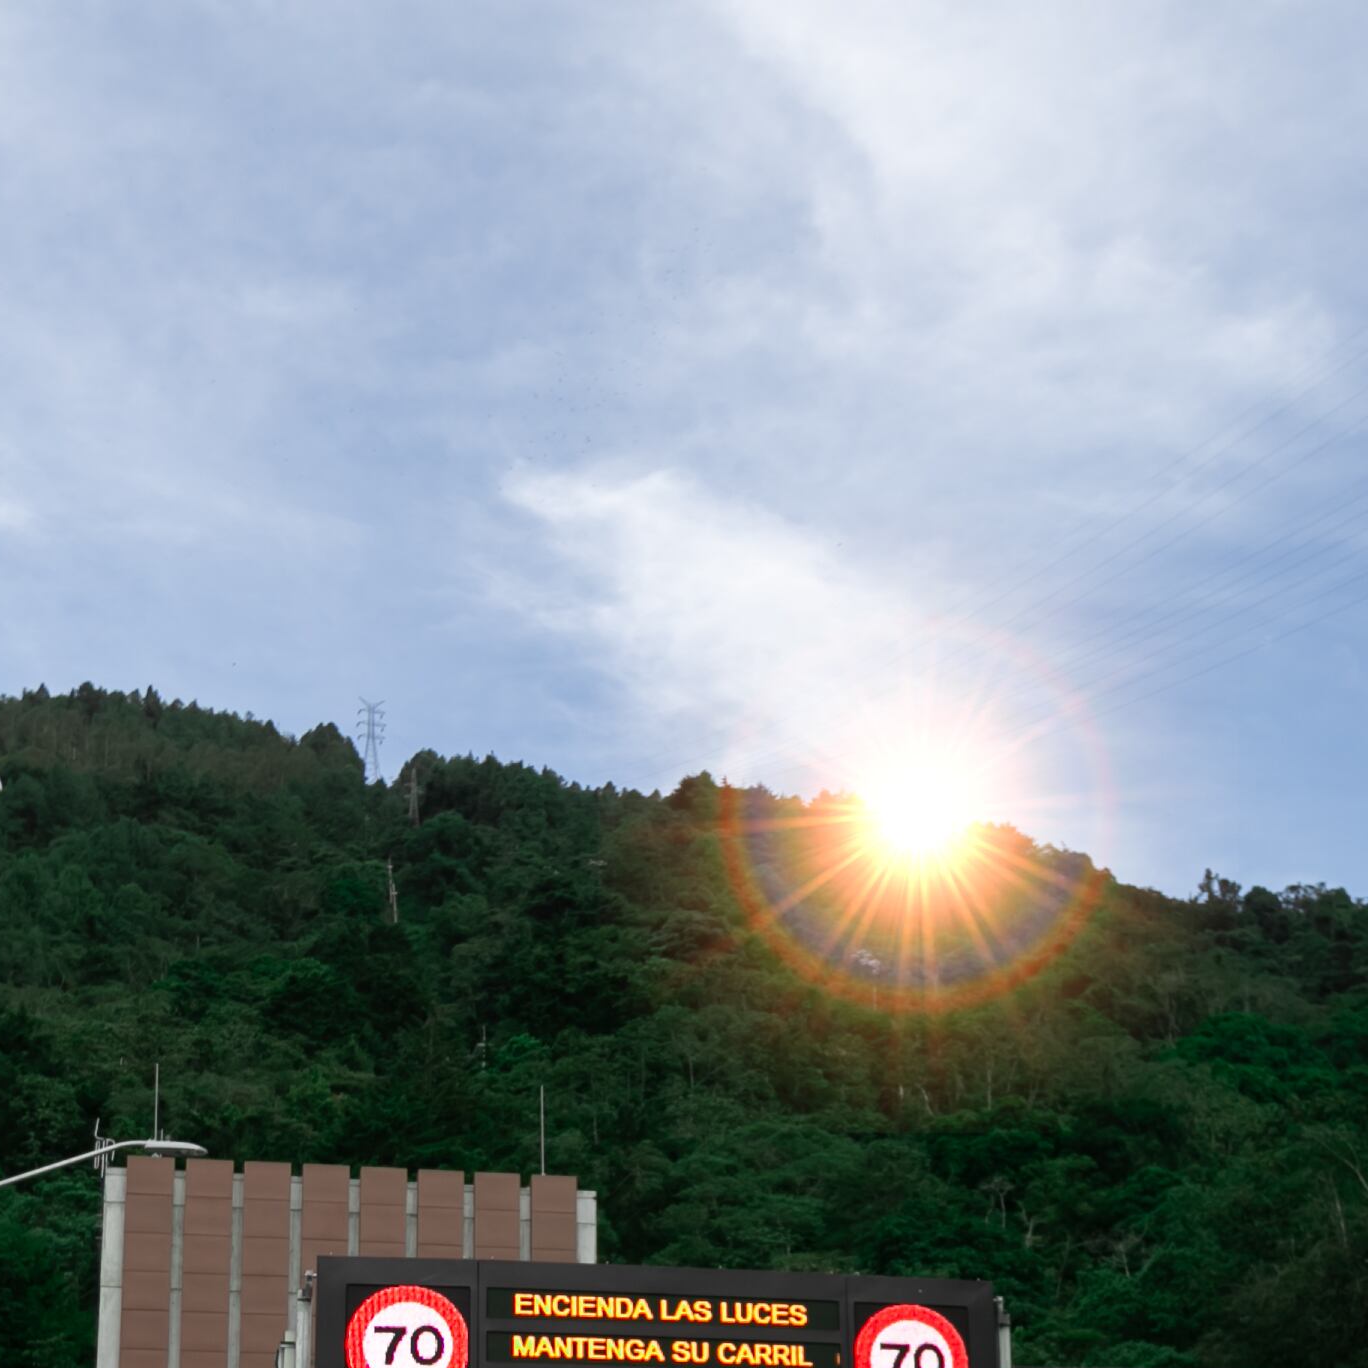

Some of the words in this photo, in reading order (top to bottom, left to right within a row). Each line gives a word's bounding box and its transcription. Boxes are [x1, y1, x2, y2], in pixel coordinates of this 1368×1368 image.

[513, 1293, 654, 1321] ENCIENDA
[659, 1298, 713, 1323] LAS
[719, 1301, 808, 1327] LUCES
[373, 1325, 445, 1366] 70
[511, 1334, 666, 1363] MANTENGA
[671, 1340, 710, 1365] SU
[715, 1342, 814, 1368] CARRIL
